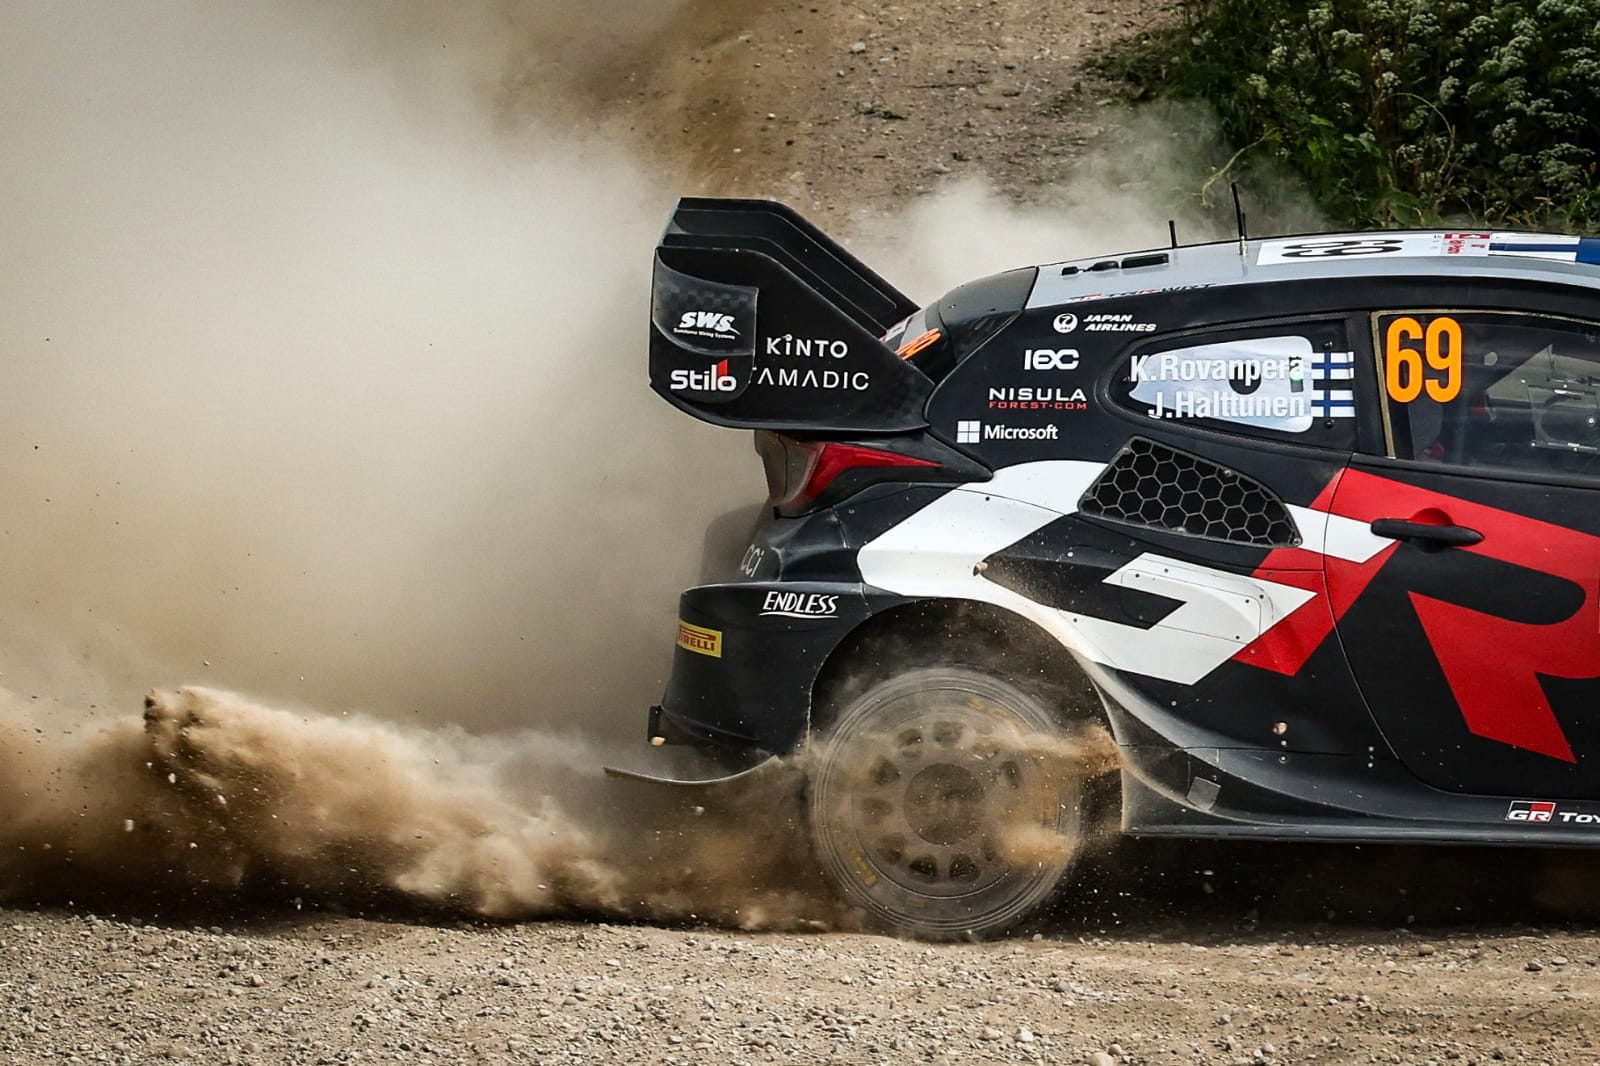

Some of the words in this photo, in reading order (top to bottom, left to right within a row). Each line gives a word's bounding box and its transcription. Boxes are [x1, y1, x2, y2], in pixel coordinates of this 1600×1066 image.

[679, 311, 739, 334] SWS
[1083, 314, 1133, 323] JAPAN
[1084, 323, 1158, 332] AIRLINES
[1386, 316, 1464, 403] 69
[670, 361, 737, 392] Stilo
[989, 387, 1088, 402] NISULA
[984, 424, 1059, 441] Microsoft
[762, 591, 840, 615] ENDLESS
[1508, 809, 1551, 821] GR
